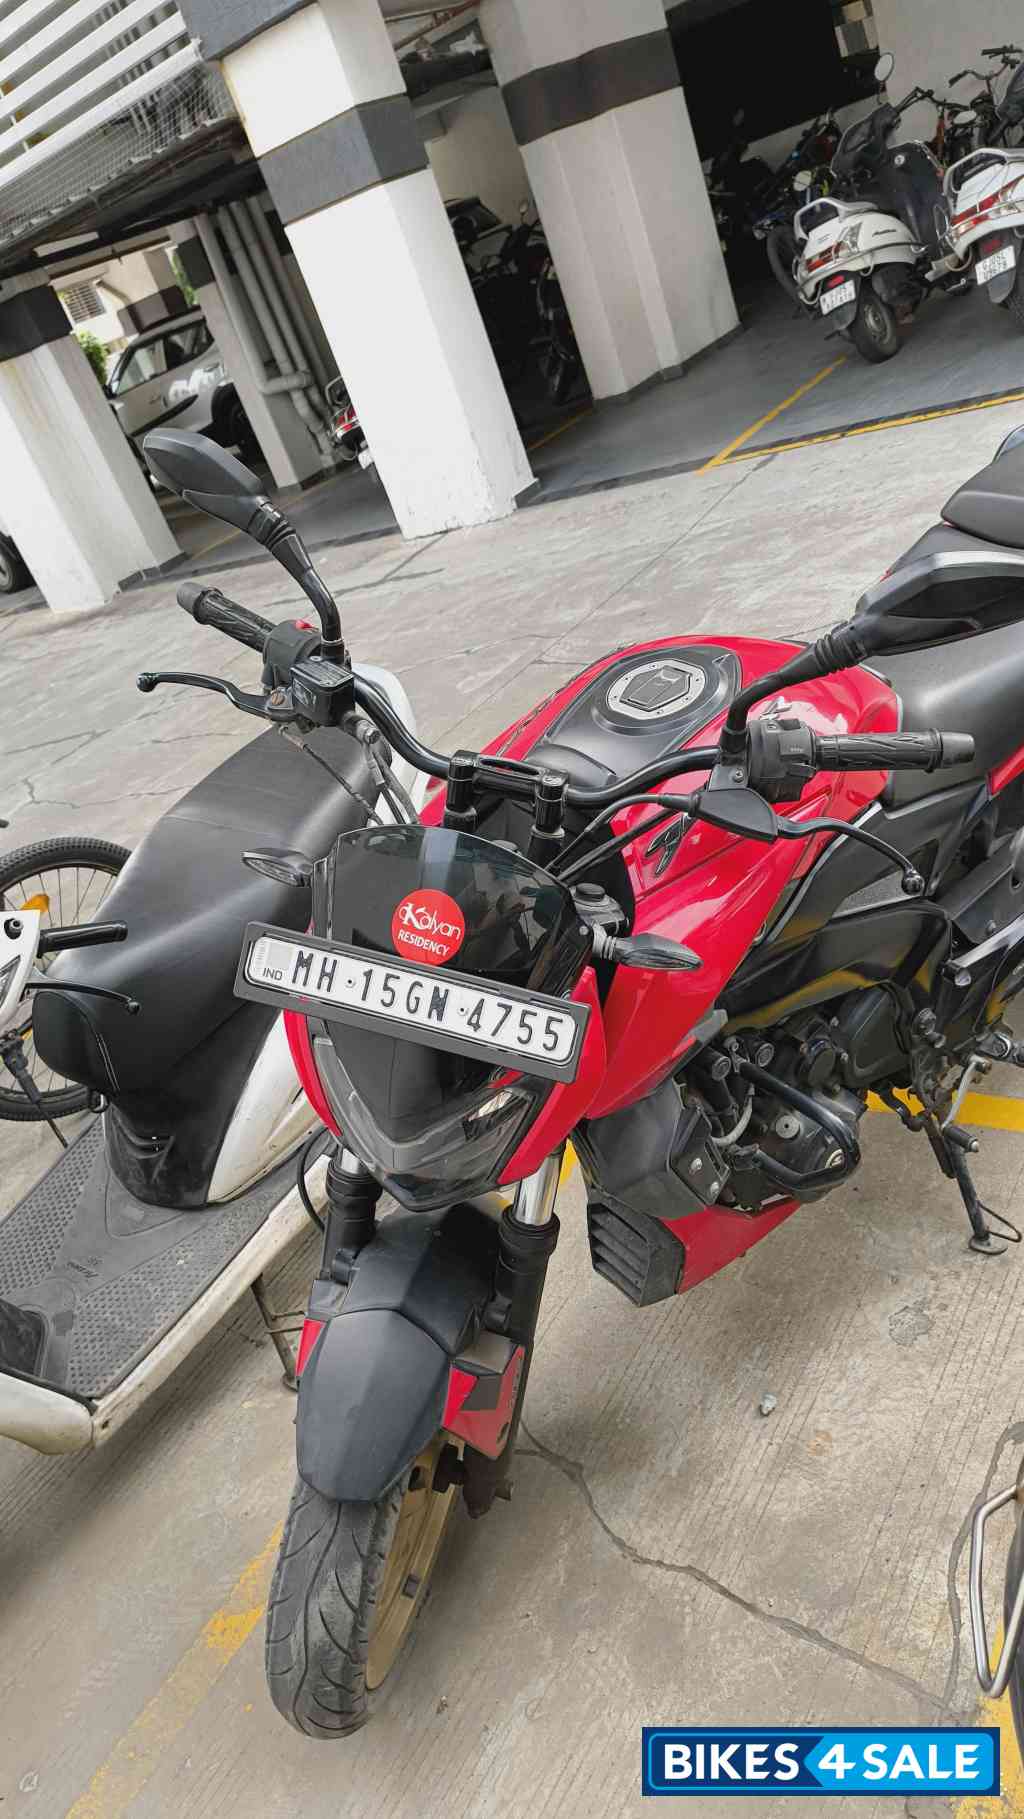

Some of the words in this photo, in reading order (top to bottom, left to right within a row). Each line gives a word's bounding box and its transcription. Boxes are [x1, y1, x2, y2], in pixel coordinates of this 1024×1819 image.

[399, 902, 461, 940] Kalyan
[398, 930, 449, 956] RESIDENCY
[263, 967, 283, 981] IND
[292, 949, 338, 993] MH
[361, 969, 449, 1022] 15GN
[466, 998, 563, 1052] 4755
